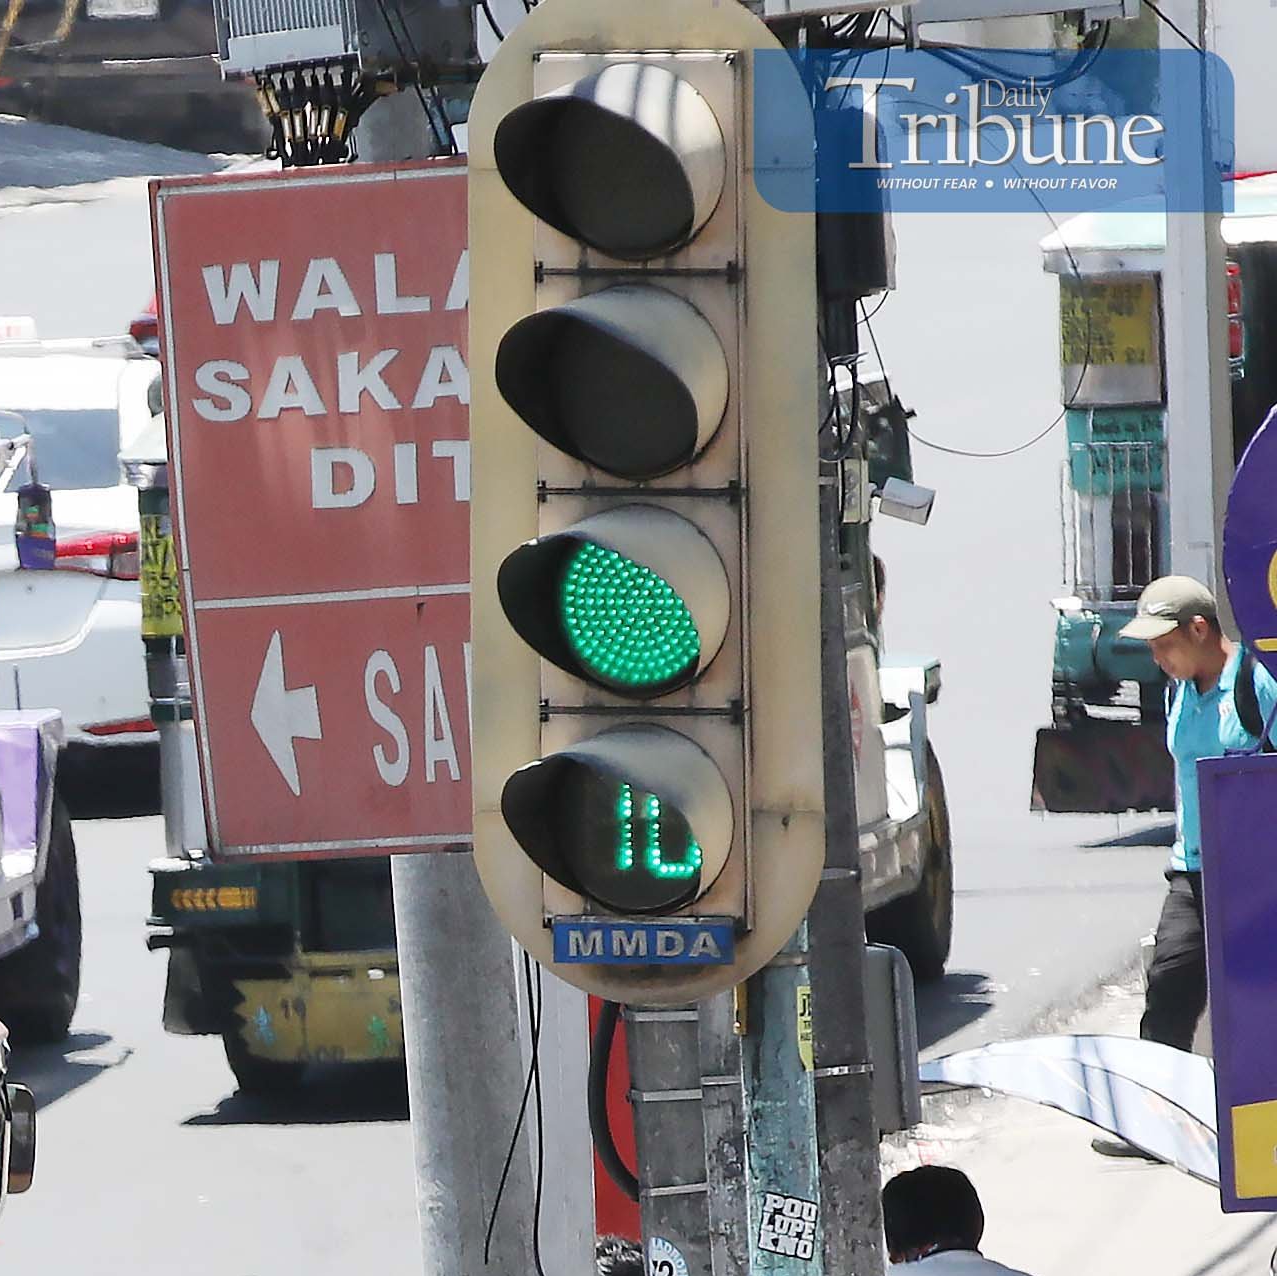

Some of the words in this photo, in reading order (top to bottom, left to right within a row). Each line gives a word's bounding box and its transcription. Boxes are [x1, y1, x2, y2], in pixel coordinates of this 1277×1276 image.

[192, 344, 470, 421] SAKA
[311, 439, 471, 509] DIT
[365, 641, 472, 787] SA
[568, 929, 722, 958] MMDA
